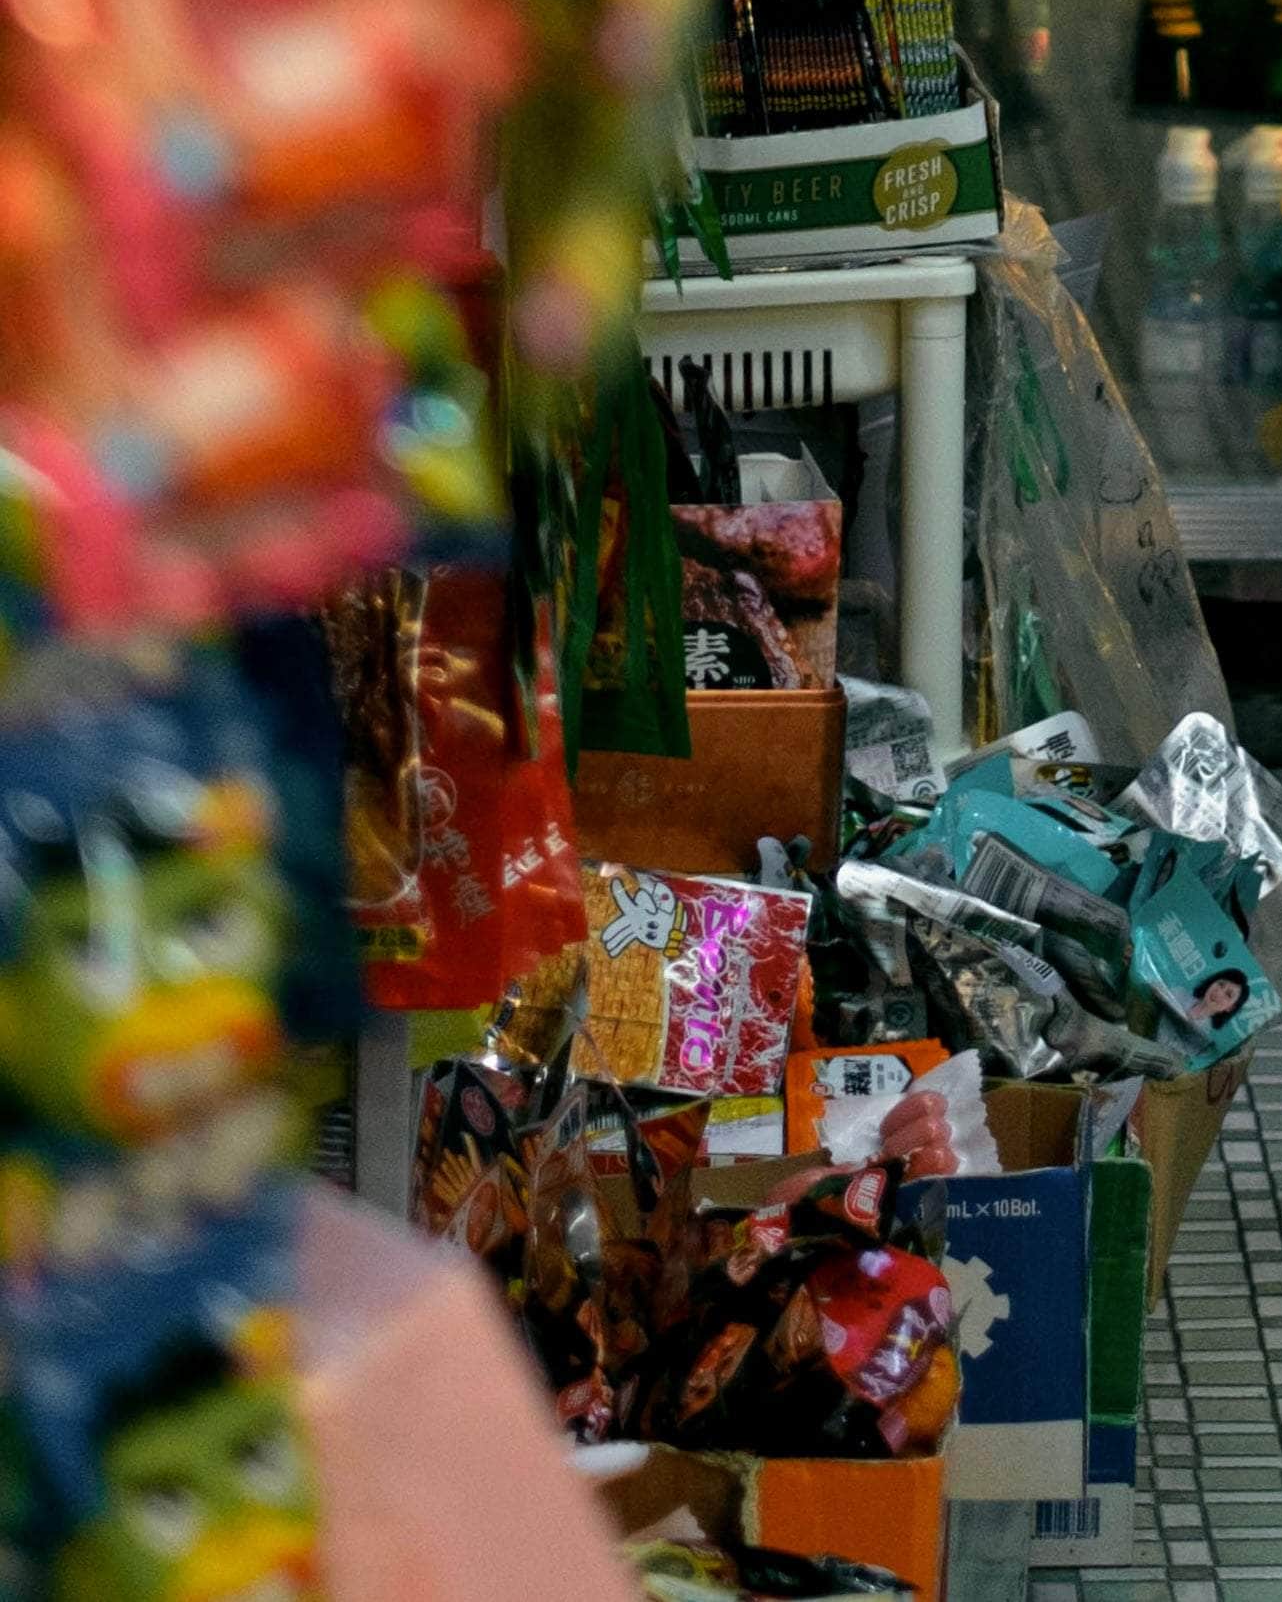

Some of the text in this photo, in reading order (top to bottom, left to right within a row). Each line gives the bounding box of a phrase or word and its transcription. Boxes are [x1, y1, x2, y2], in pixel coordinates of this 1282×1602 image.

[772, 174, 843, 205] BEER
[884, 155, 942, 191] FRESH
[767, 209, 799, 223] CANS
[884, 190, 941, 226] CRISP
